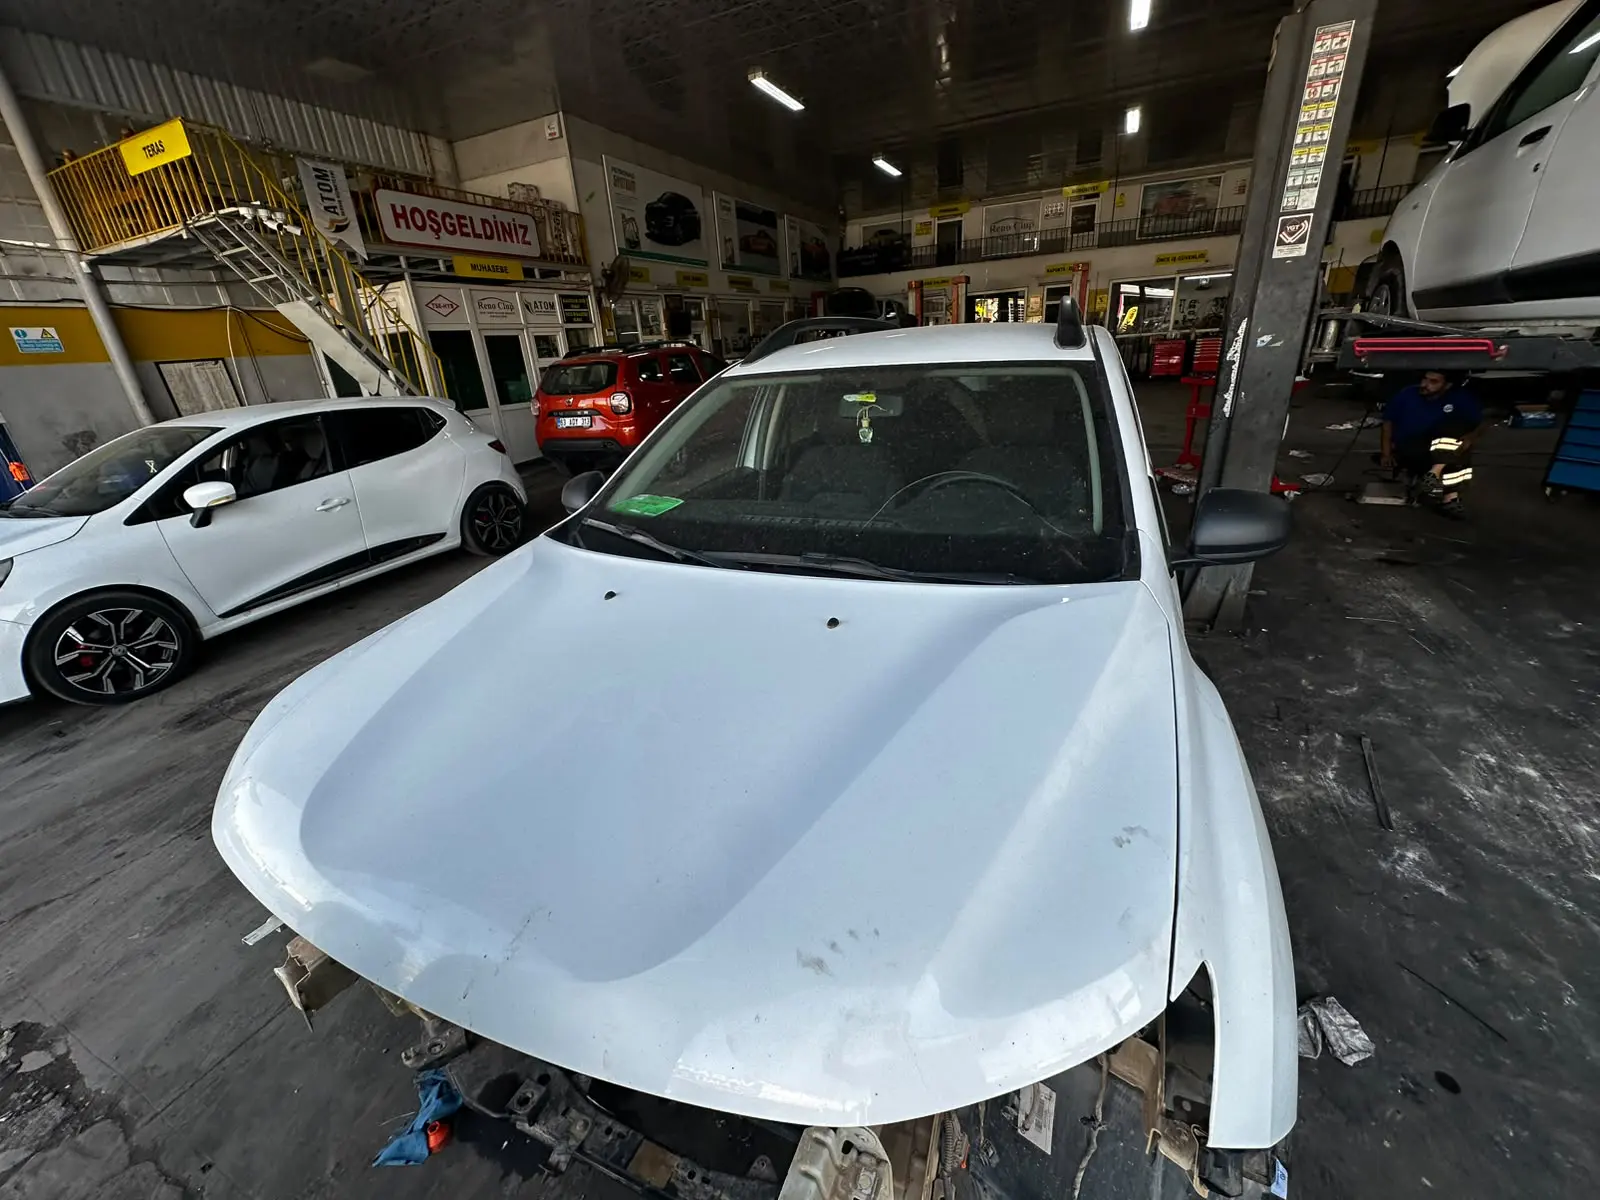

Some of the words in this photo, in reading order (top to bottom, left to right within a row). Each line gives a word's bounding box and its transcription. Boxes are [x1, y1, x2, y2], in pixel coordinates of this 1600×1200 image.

[142, 140, 165, 159] TERAS
[312, 167, 339, 216] ATOM
[390, 203, 532, 246] HOŞGELDİNİZ
[470, 263, 510, 274] MUHASEBE
[478, 301, 496, 310] Reno
[533, 300, 556, 311] ATOM
